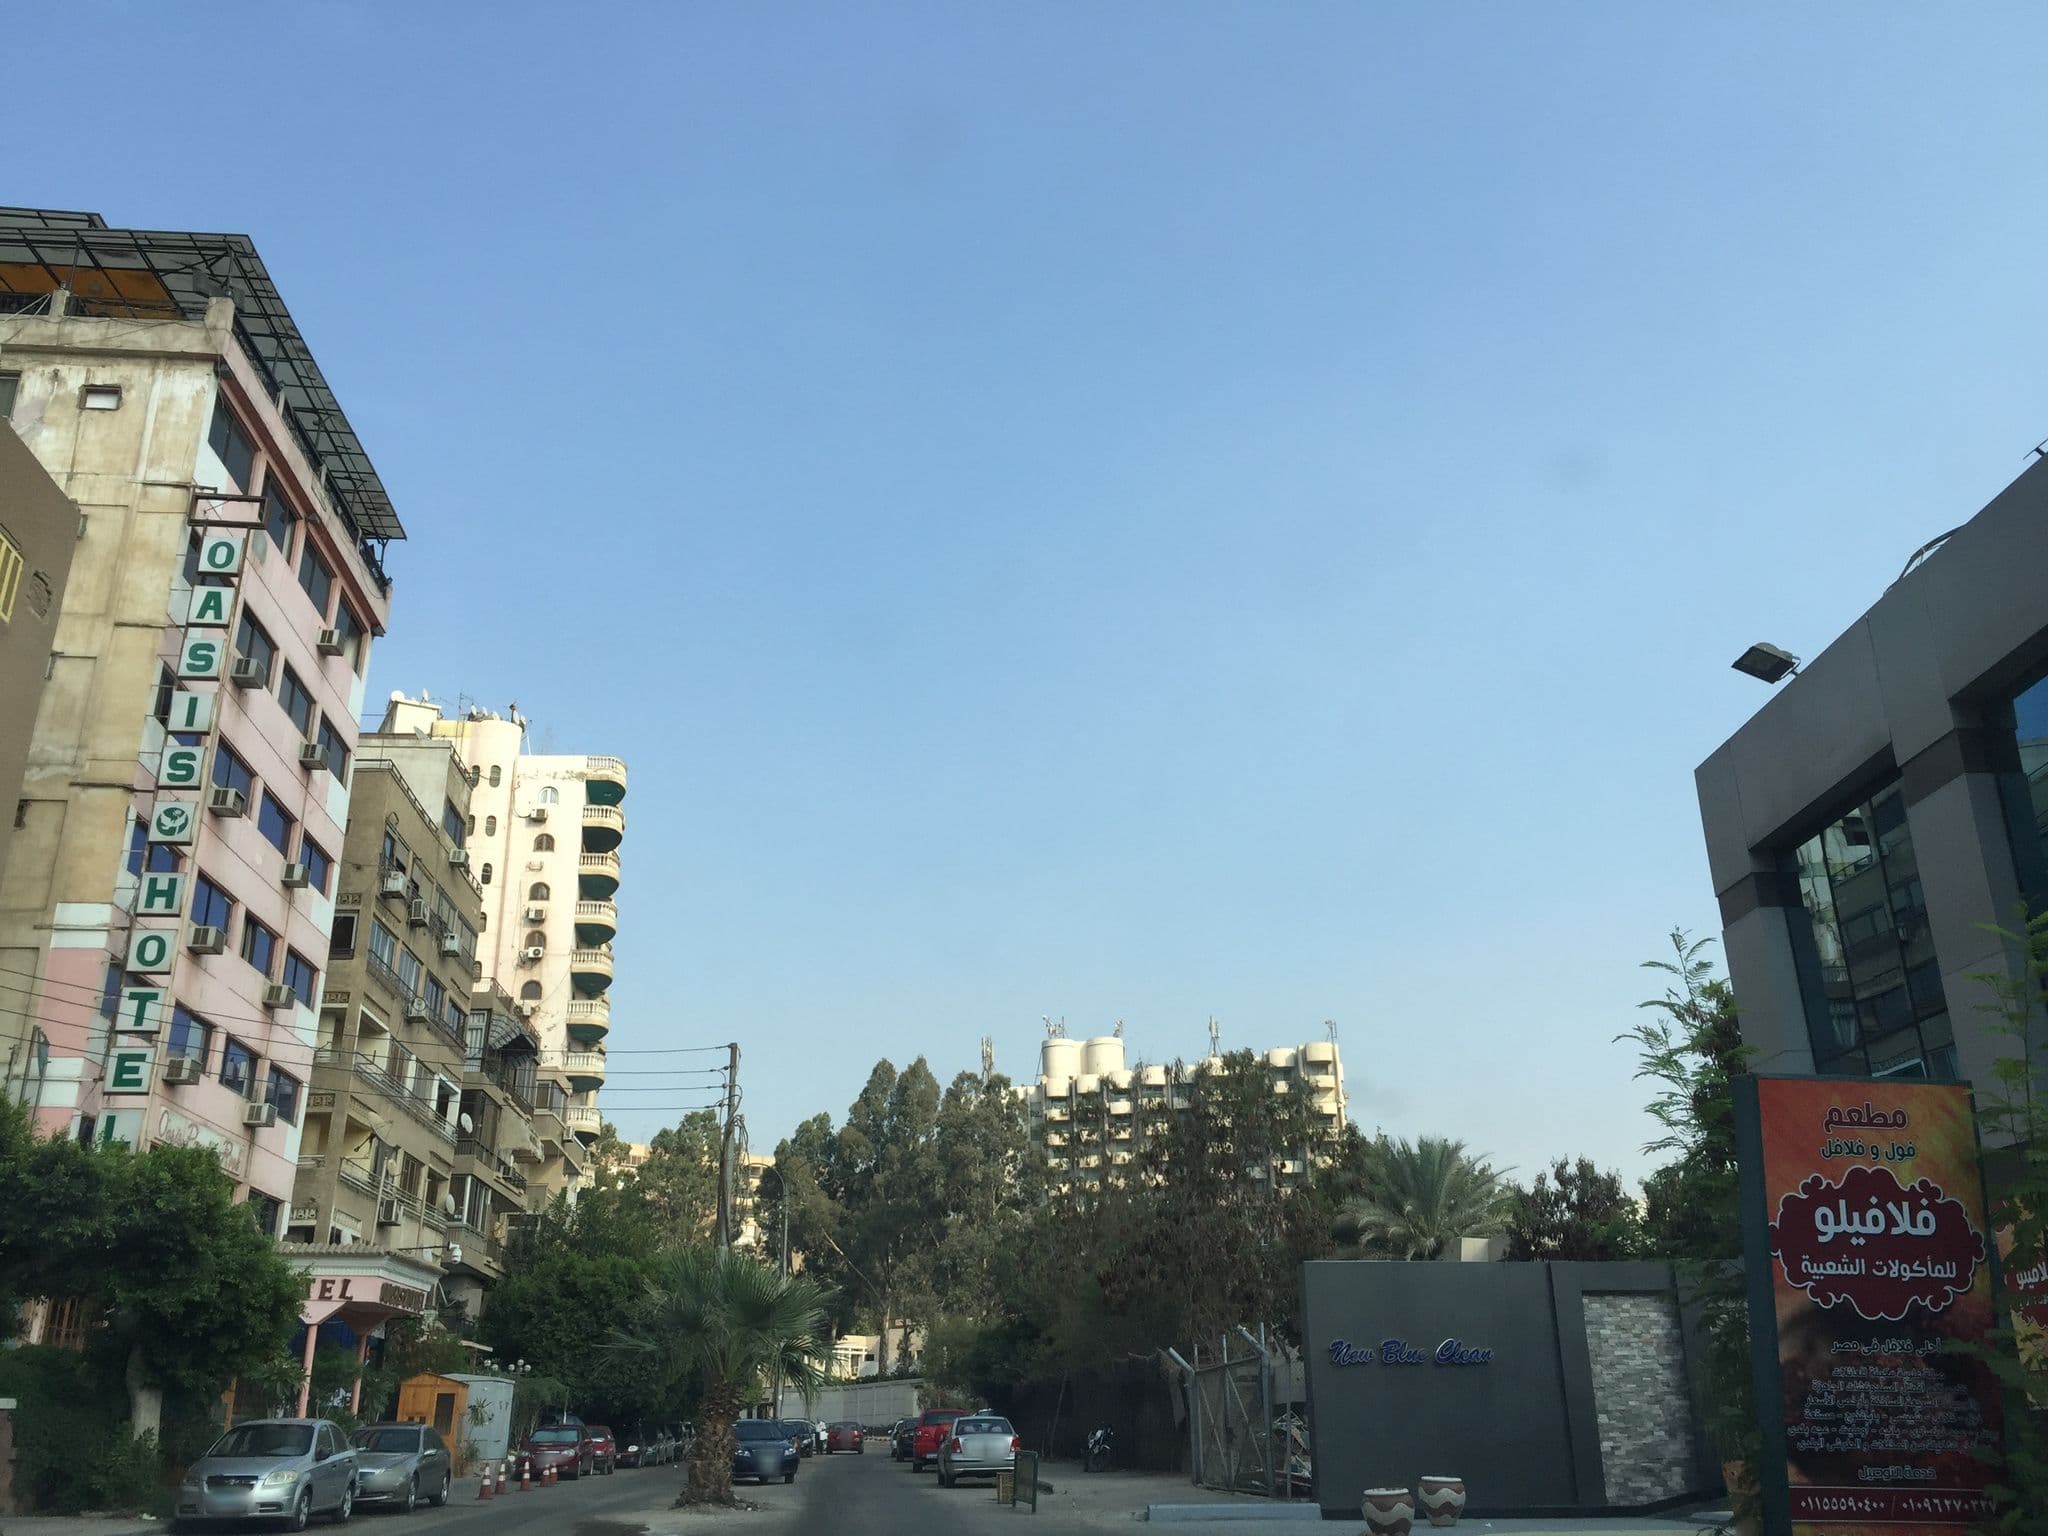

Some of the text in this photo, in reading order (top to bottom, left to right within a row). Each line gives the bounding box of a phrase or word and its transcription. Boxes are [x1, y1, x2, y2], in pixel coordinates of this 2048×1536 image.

[1823, 1101, 1909, 1133] مطعم
[1820, 1139, 1916, 1160] فول و فلافل
[1814, 1196, 1936, 1247] فلافيلو
[1800, 1254, 1957, 1280] للمأكولات الشعبية
[1329, 1337, 1494, 1366] New Blue Clean
[1830, 1341, 1859, 1354] مصر
[1881, 1338, 1913, 1355] فلافل
[1915, 1337, 1941, 1357] أحلى
